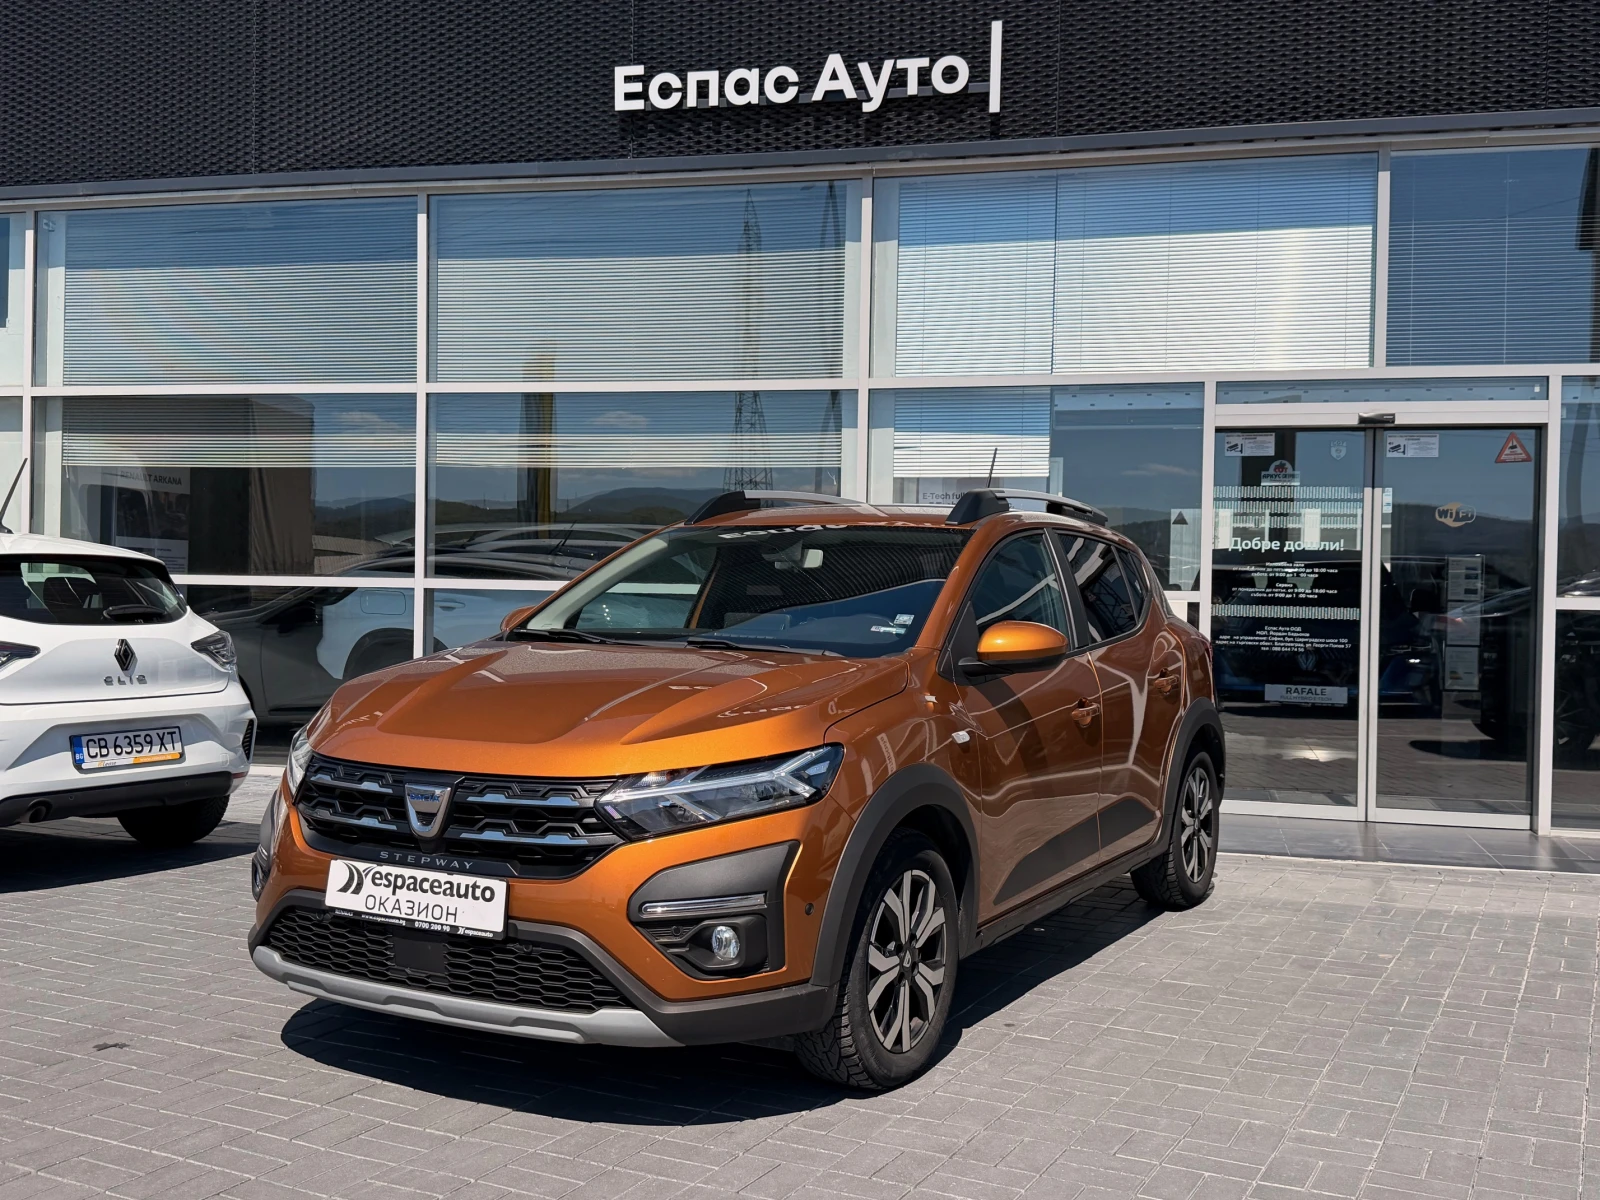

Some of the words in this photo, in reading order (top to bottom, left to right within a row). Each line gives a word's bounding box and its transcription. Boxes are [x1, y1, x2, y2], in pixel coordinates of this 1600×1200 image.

[614, 64, 799, 112] Еспас
[811, 53, 970, 113] Ауто
[153, 475, 182, 486] ARKANA
[922, 492, 950, 500] E-Tech
[1229, 537, 1280, 553] Добре
[1284, 539, 1344, 552] дошли!
[1285, 687, 1327, 696] RAFALE
[86, 737, 110, 759] CB
[113, 733, 153, 756] 6359
[156, 731, 176, 753] XT
[380, 851, 473, 870] STEPWAY
[371, 870, 495, 903] espaceauto
[364, 894, 458, 923] ОКАЗИОН
[414, 921, 429, 930] 0700
[430, 922, 442, 931] 200
[464, 929, 494, 938] espaceauto
